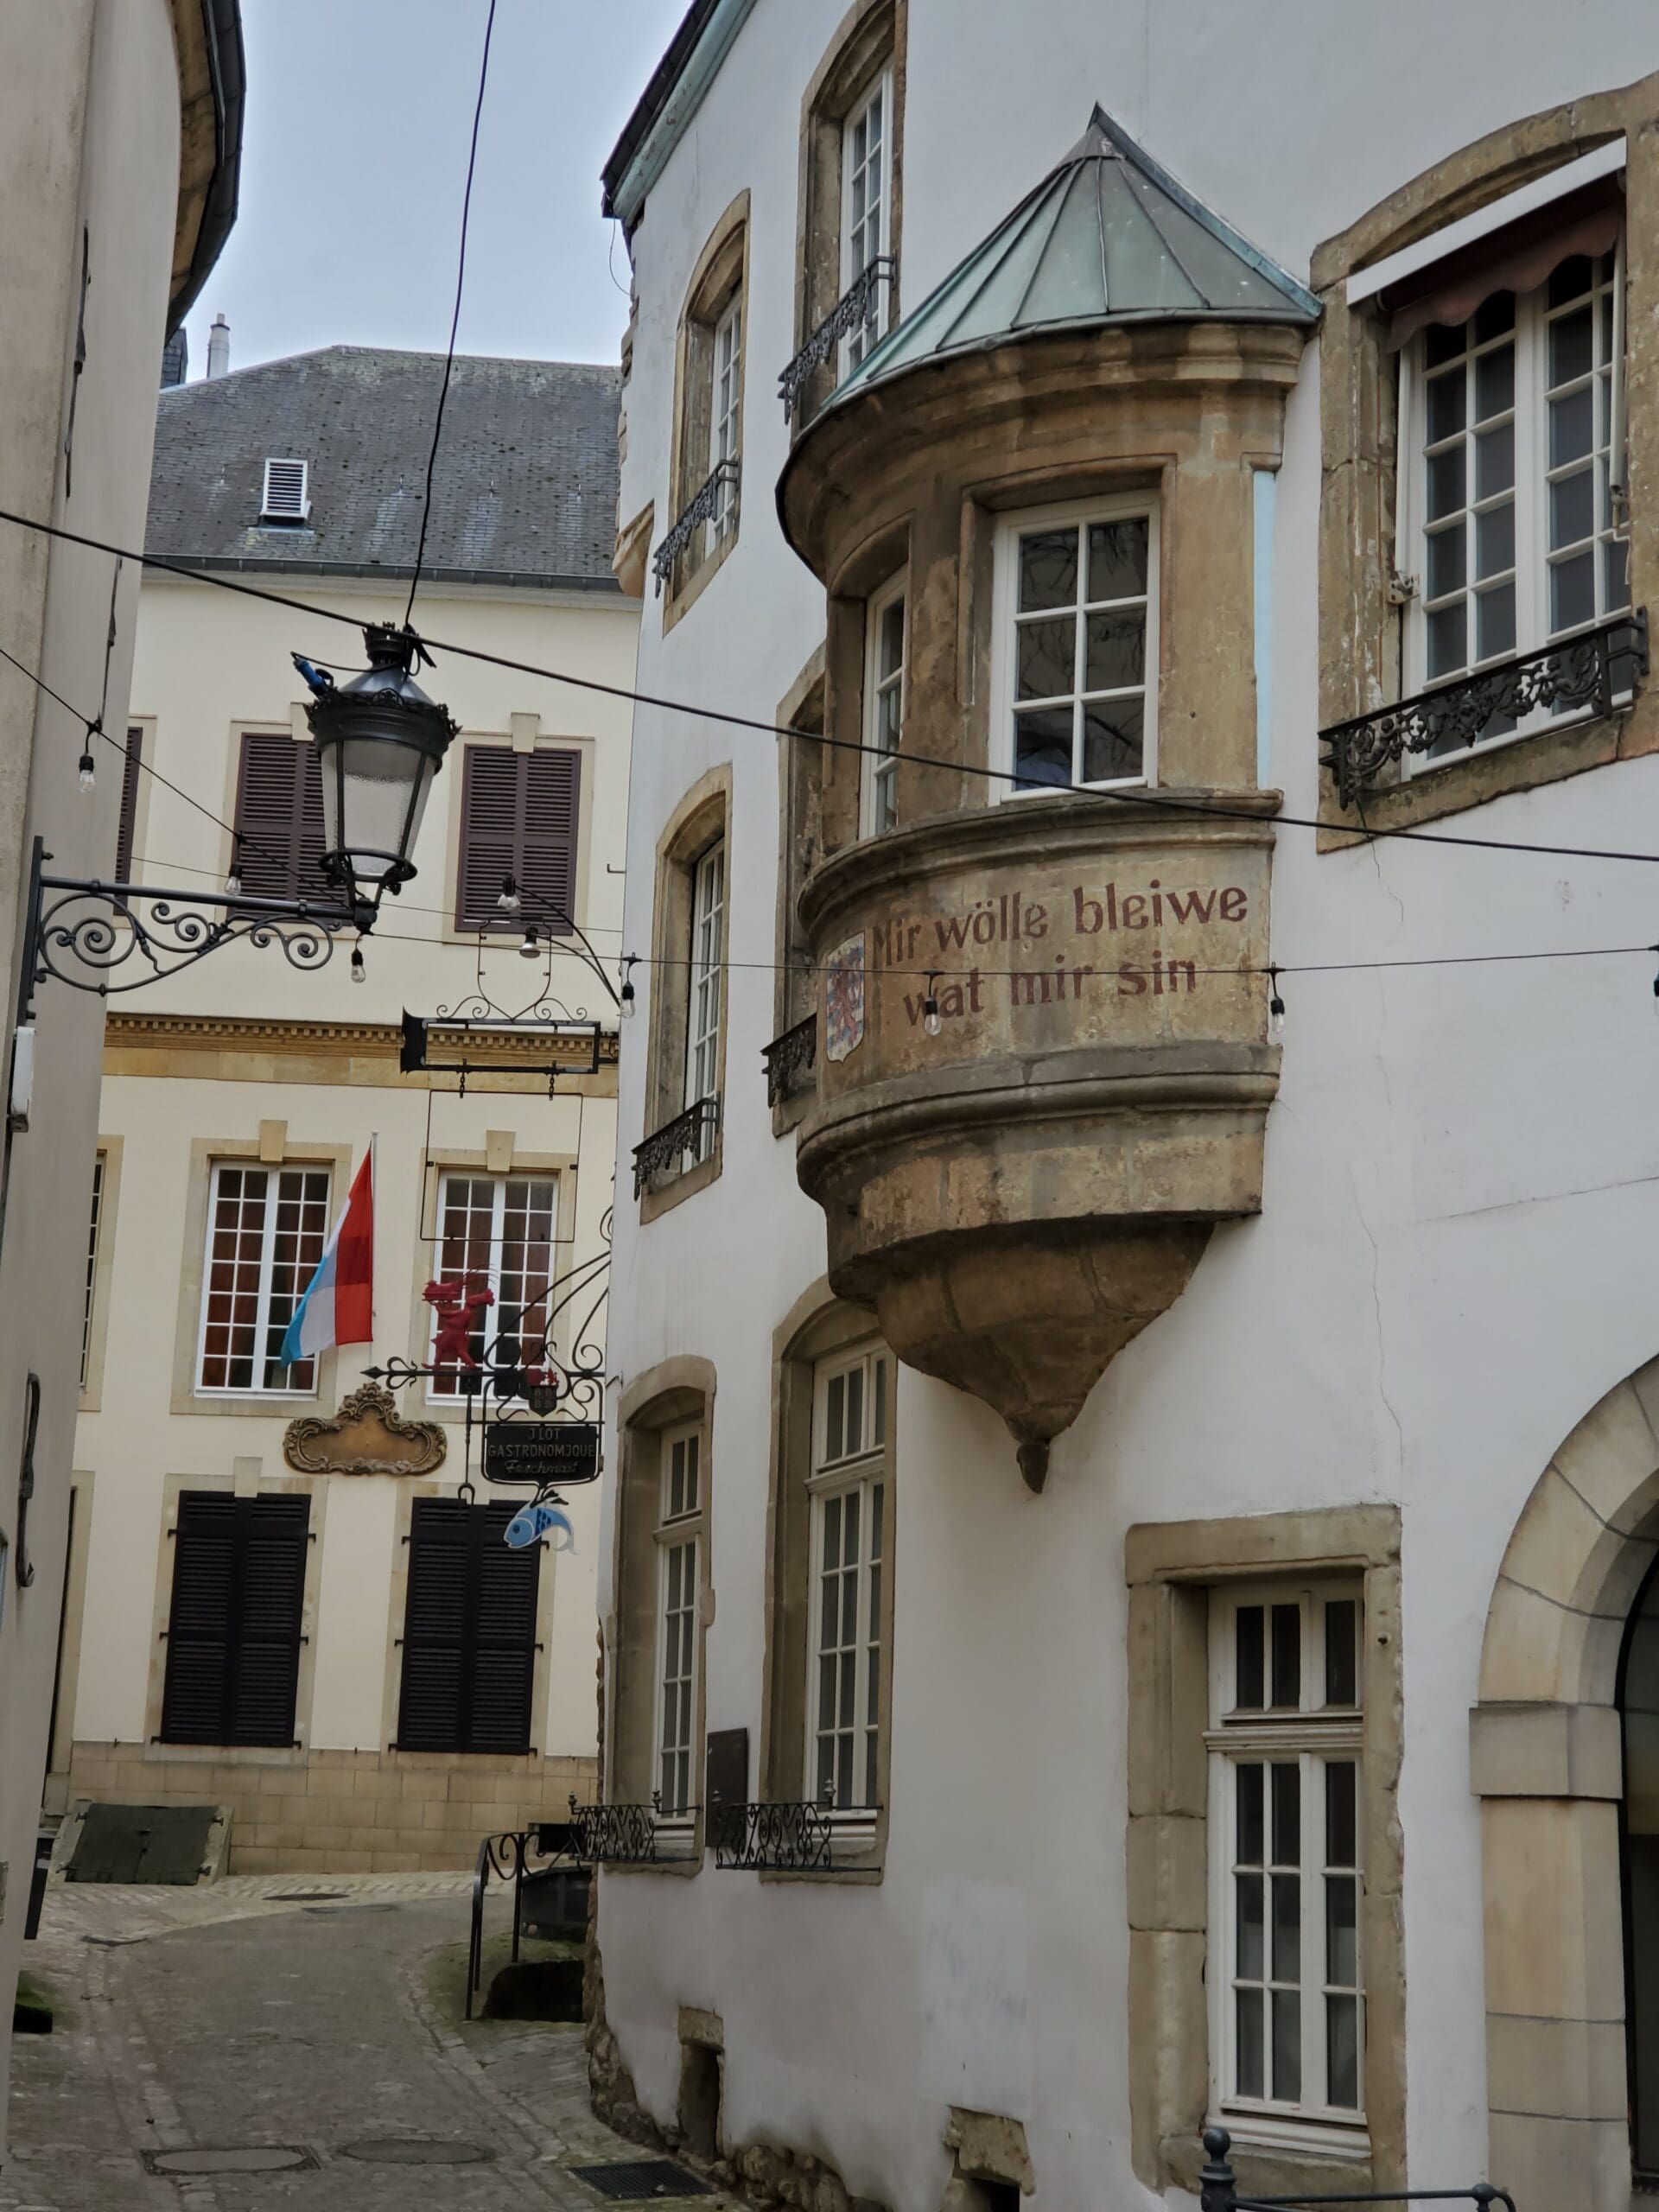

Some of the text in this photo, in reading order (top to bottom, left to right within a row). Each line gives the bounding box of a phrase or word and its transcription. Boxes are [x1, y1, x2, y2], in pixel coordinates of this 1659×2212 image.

[872, 880, 1248, 968] Mir wölle bleiwe
[903, 950, 1196, 1026] wat mir sin
